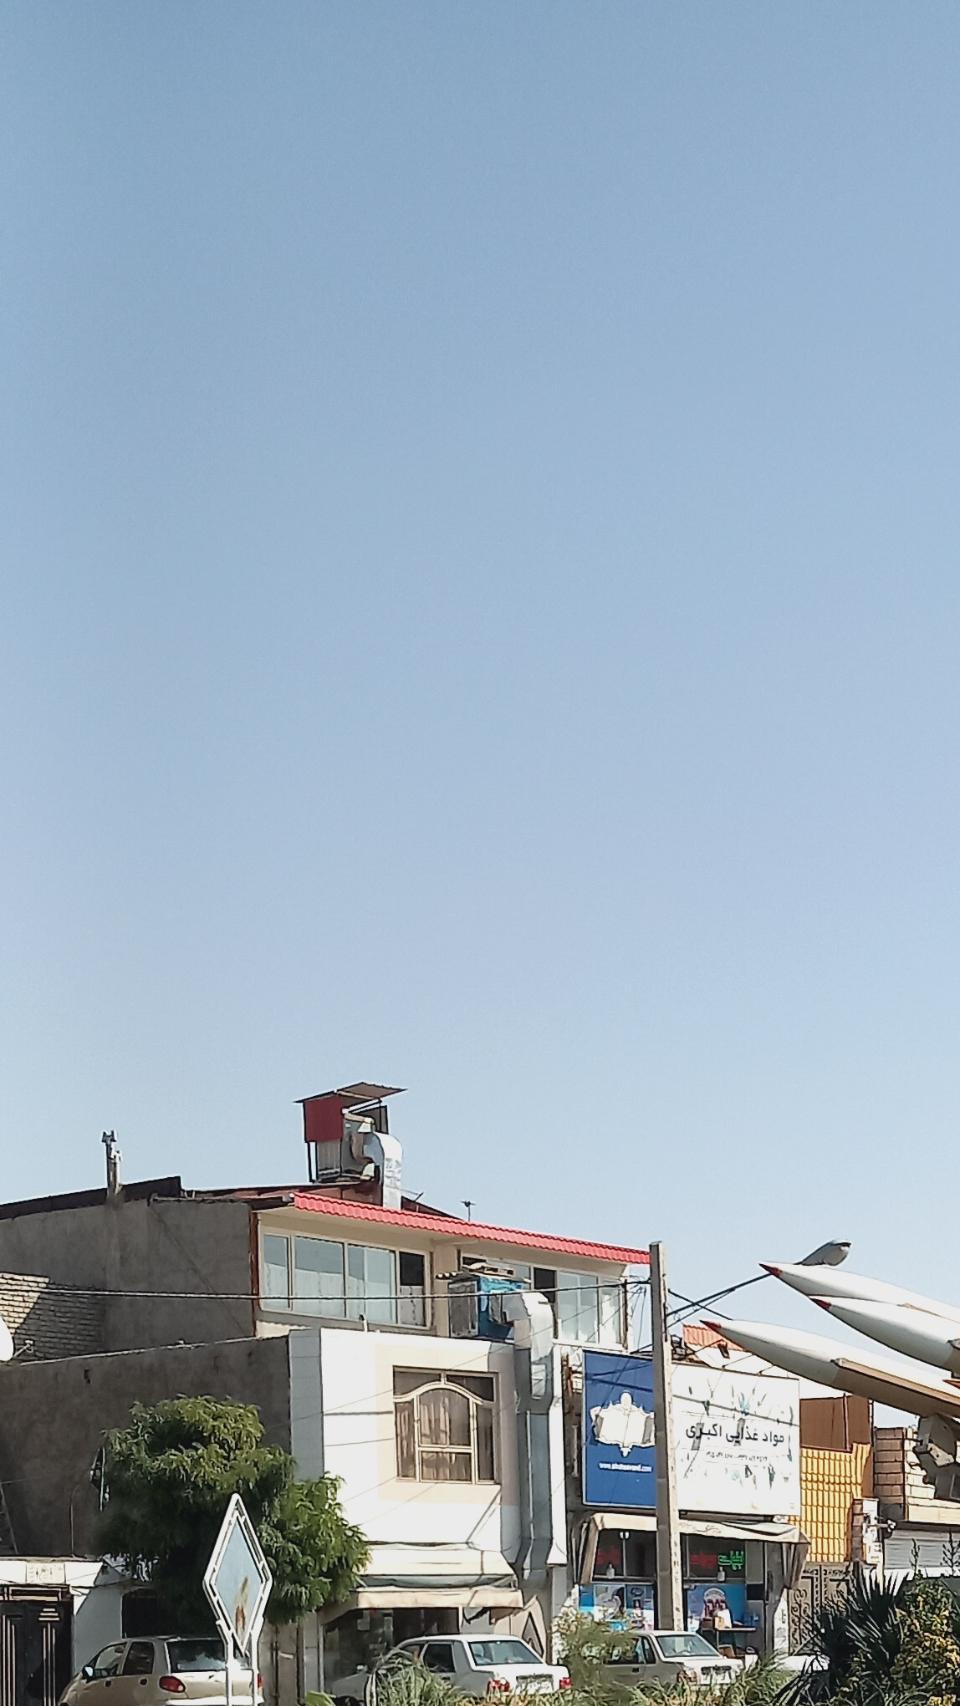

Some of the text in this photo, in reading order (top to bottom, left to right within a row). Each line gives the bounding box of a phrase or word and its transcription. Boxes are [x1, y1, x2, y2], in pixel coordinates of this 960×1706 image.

[685, 1423, 785, 1447] مواد غذایی اکبری
